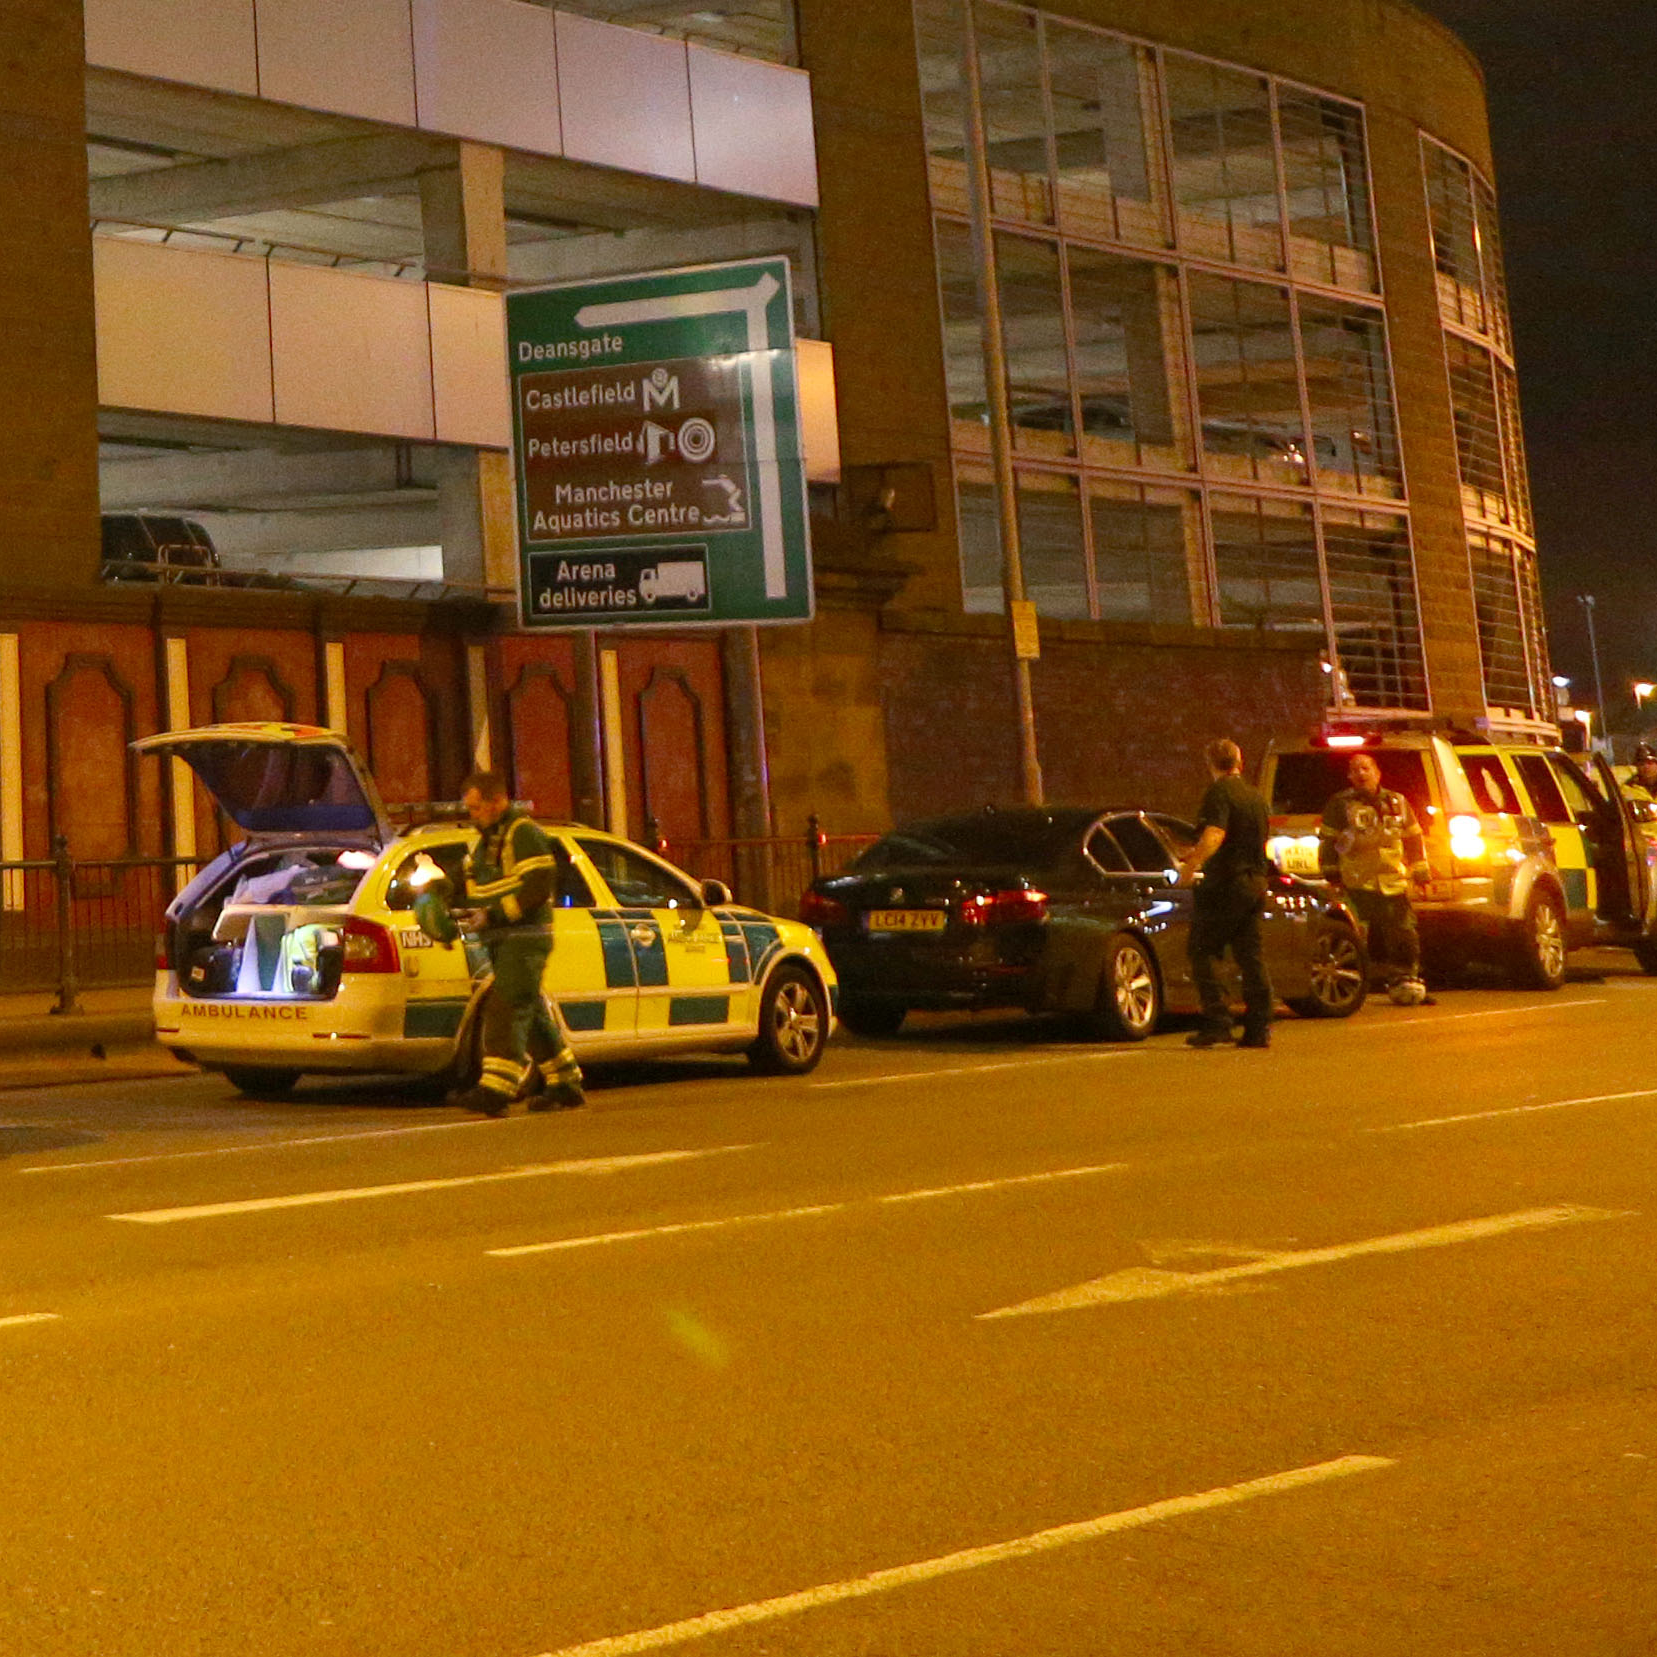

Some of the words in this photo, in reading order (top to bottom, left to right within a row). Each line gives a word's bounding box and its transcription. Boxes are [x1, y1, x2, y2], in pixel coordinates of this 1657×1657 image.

[518, 332, 624, 363] Deansgate
[525, 380, 636, 411] Castlefield
[528, 431, 634, 459] Petersfield
[554, 479, 674, 505] Manchester
[532, 507, 621, 534] Aquatics
[627, 502, 701, 527] Centre
[556, 558, 616, 582] Arena
[538, 584, 637, 609] deliveries
[181, 1003, 309, 1020] AMBULANCE
